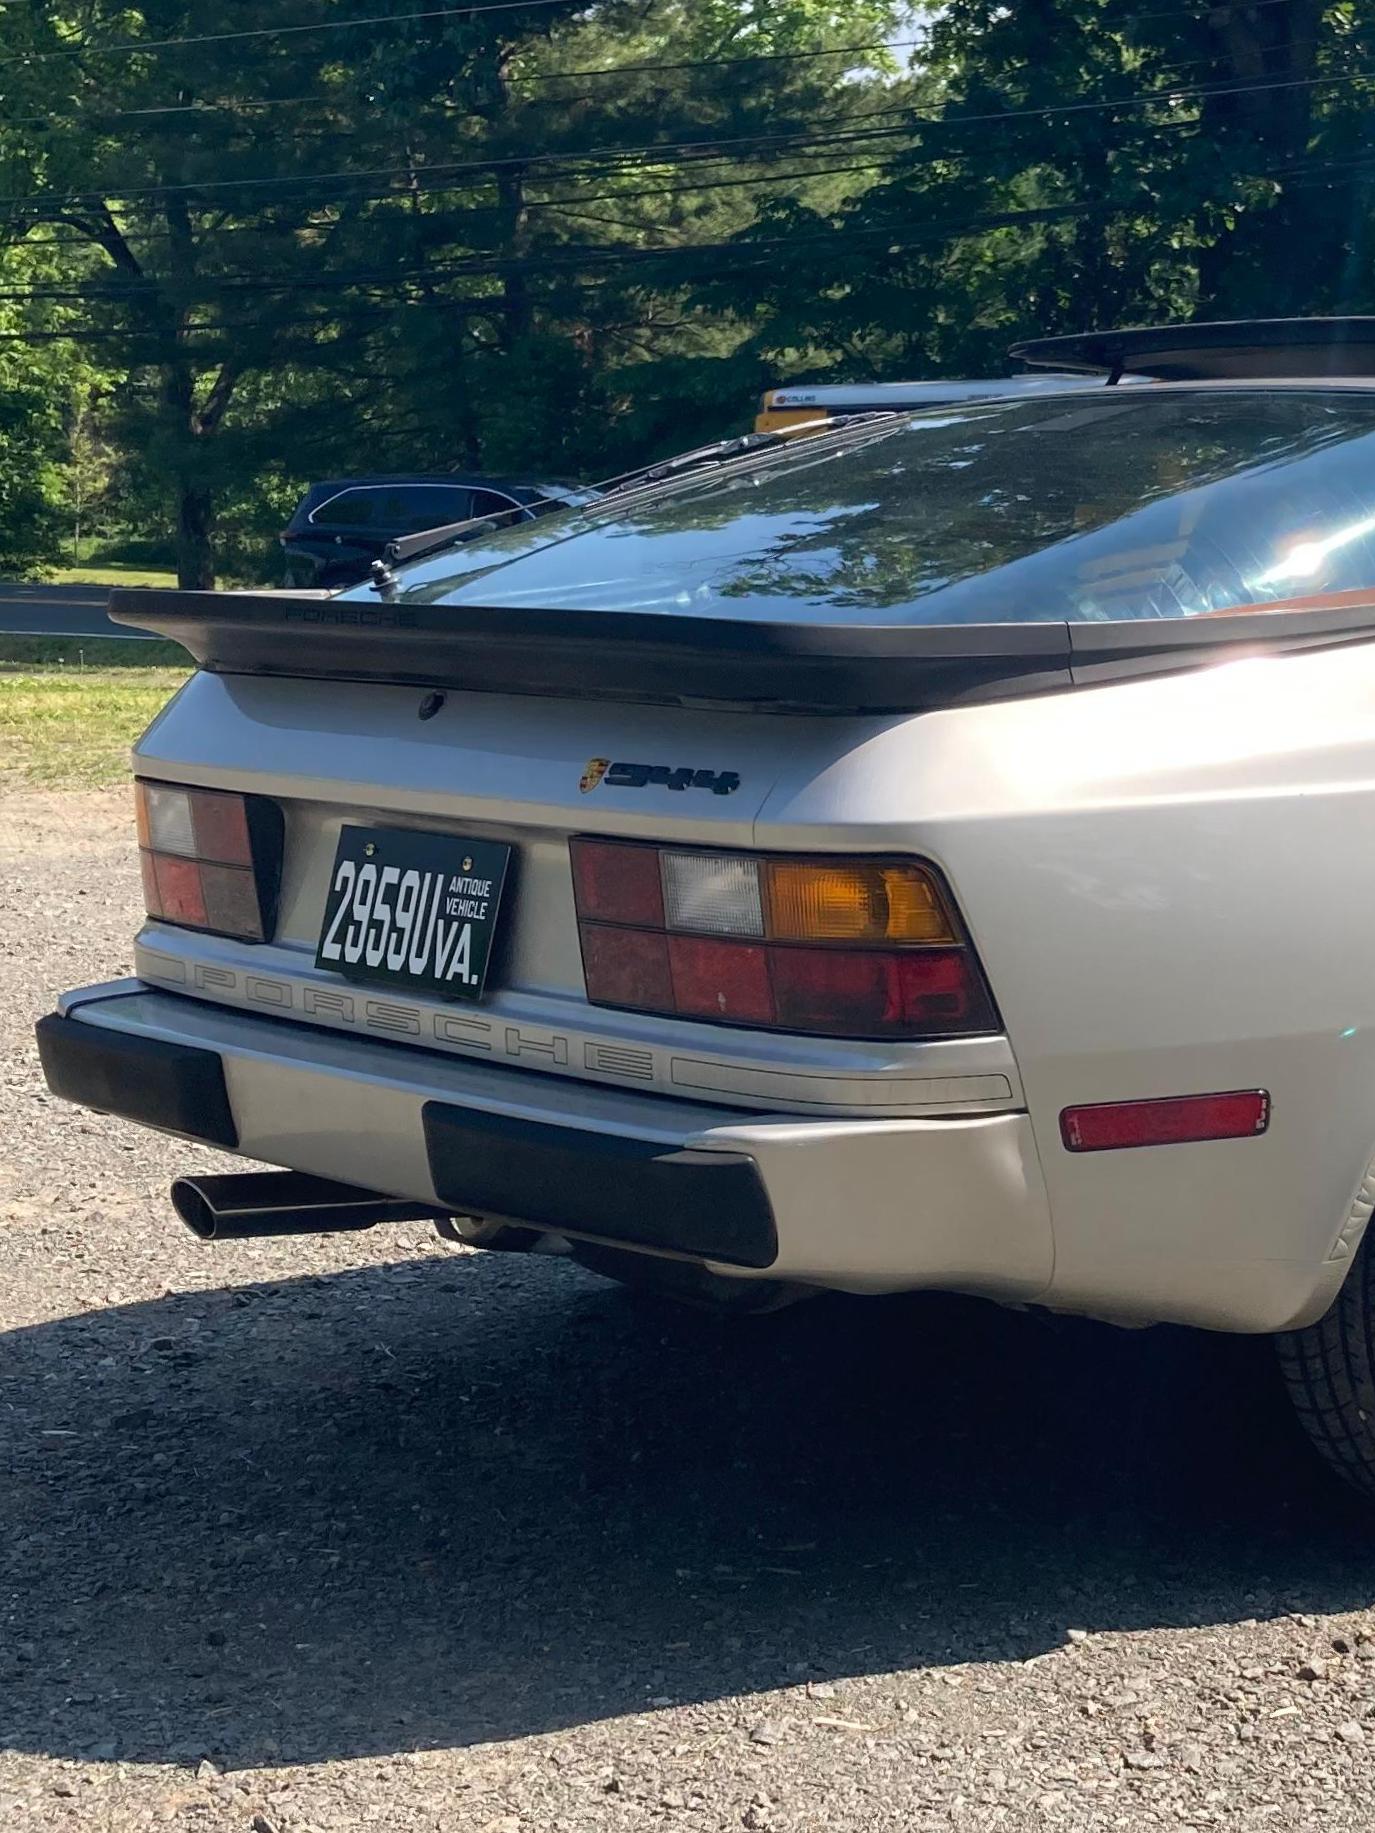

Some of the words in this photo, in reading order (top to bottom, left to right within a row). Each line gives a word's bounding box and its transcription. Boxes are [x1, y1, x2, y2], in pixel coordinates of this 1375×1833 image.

[285, 607, 417, 627] PORSCHE
[604, 762, 740, 796] 944
[449, 876, 492, 898] ANTIQUE
[321, 860, 444, 975] 2959U
[446, 897, 488, 920] VEHICLE
[195, 964, 654, 1080] PORSCHE
